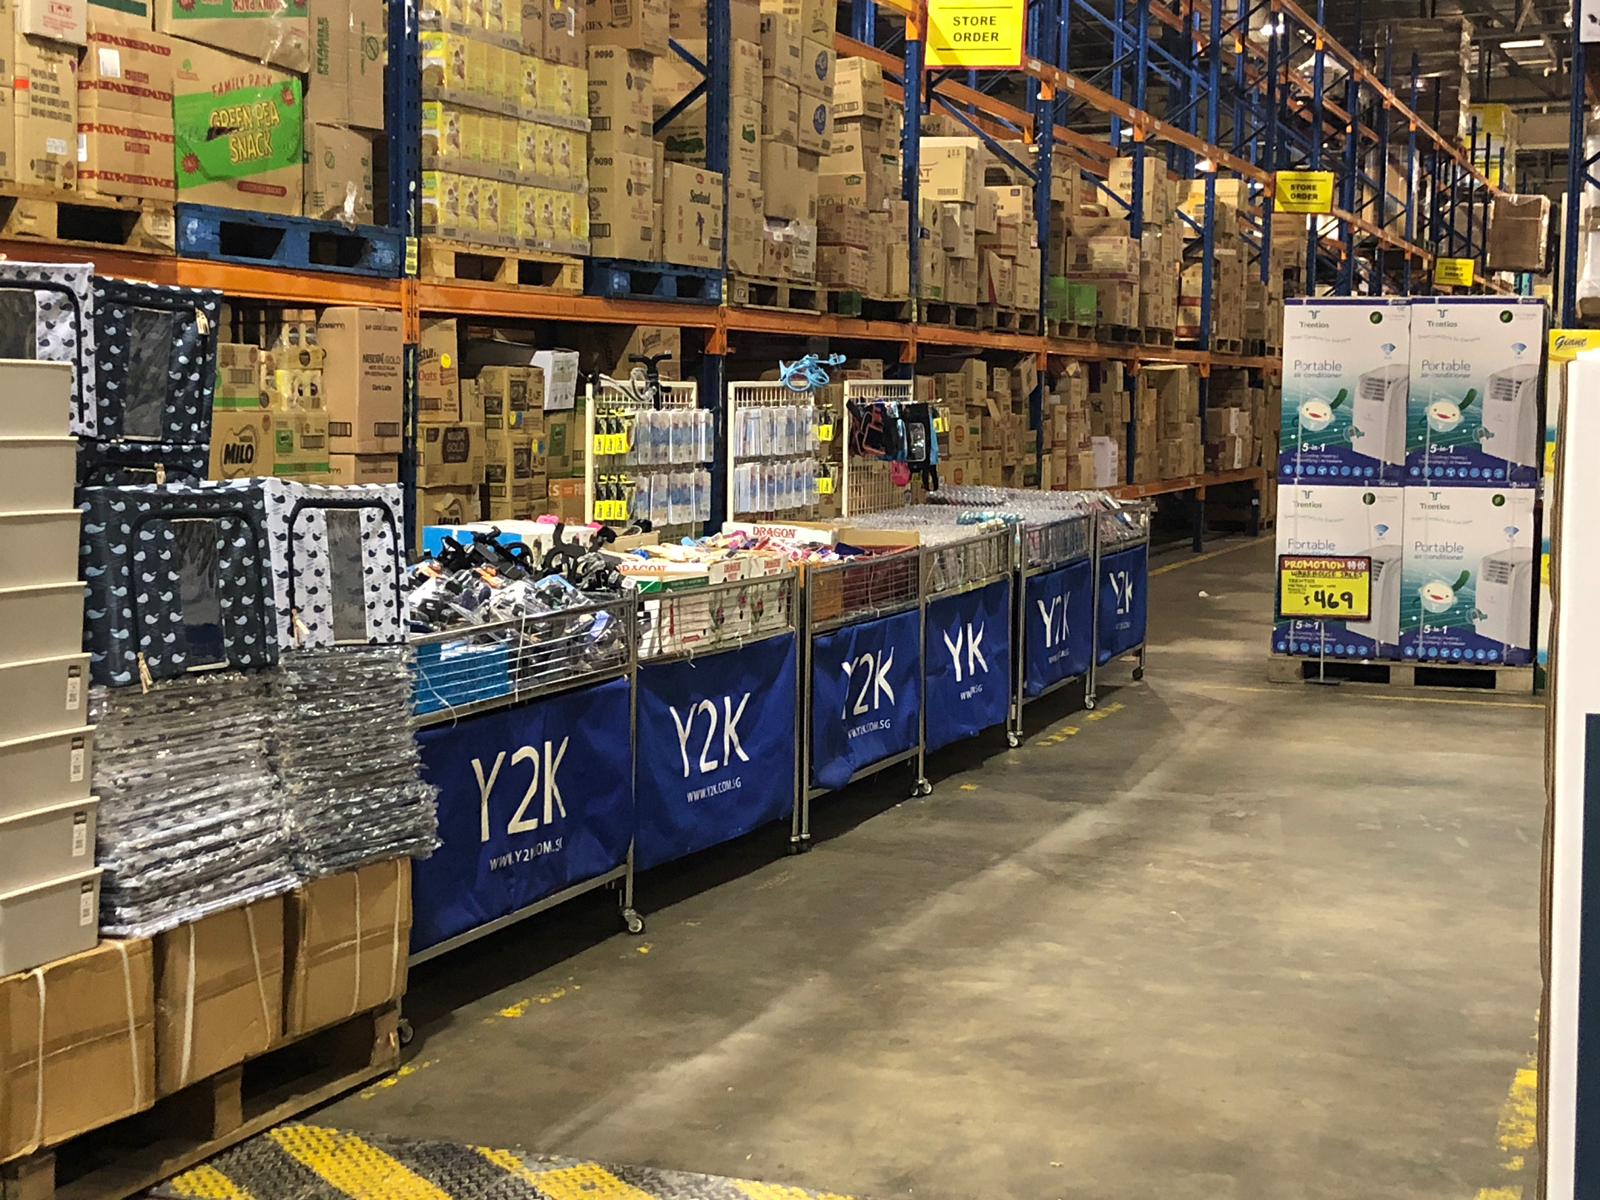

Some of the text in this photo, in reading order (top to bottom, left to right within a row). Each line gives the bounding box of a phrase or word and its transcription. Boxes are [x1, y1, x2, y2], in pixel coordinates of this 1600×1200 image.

[953, 16, 997, 26] STORE
[953, 32, 999, 42] ORDER
[212, 73, 273, 97] FAMILY PACK
[210, 100, 280, 131] GREEN PEA
[231, 129, 273, 164] SNACK
[1555, 335, 1588, 351] Giant
[1294, 360, 1342, 371] Portable
[1422, 360, 1471, 371] Portable
[224, 443, 254, 464] MILO
[752, 526, 796, 539] DRAGON
[1288, 538, 1336, 550] Portable
[1415, 541, 1464, 553] Portable
[1284, 560, 1345, 569] PROMOTION
[943, 621, 989, 682] YK
[841, 646, 895, 720] Y2K
[669, 692, 751, 778] Y2K
[471, 735, 569, 843] Y2K
